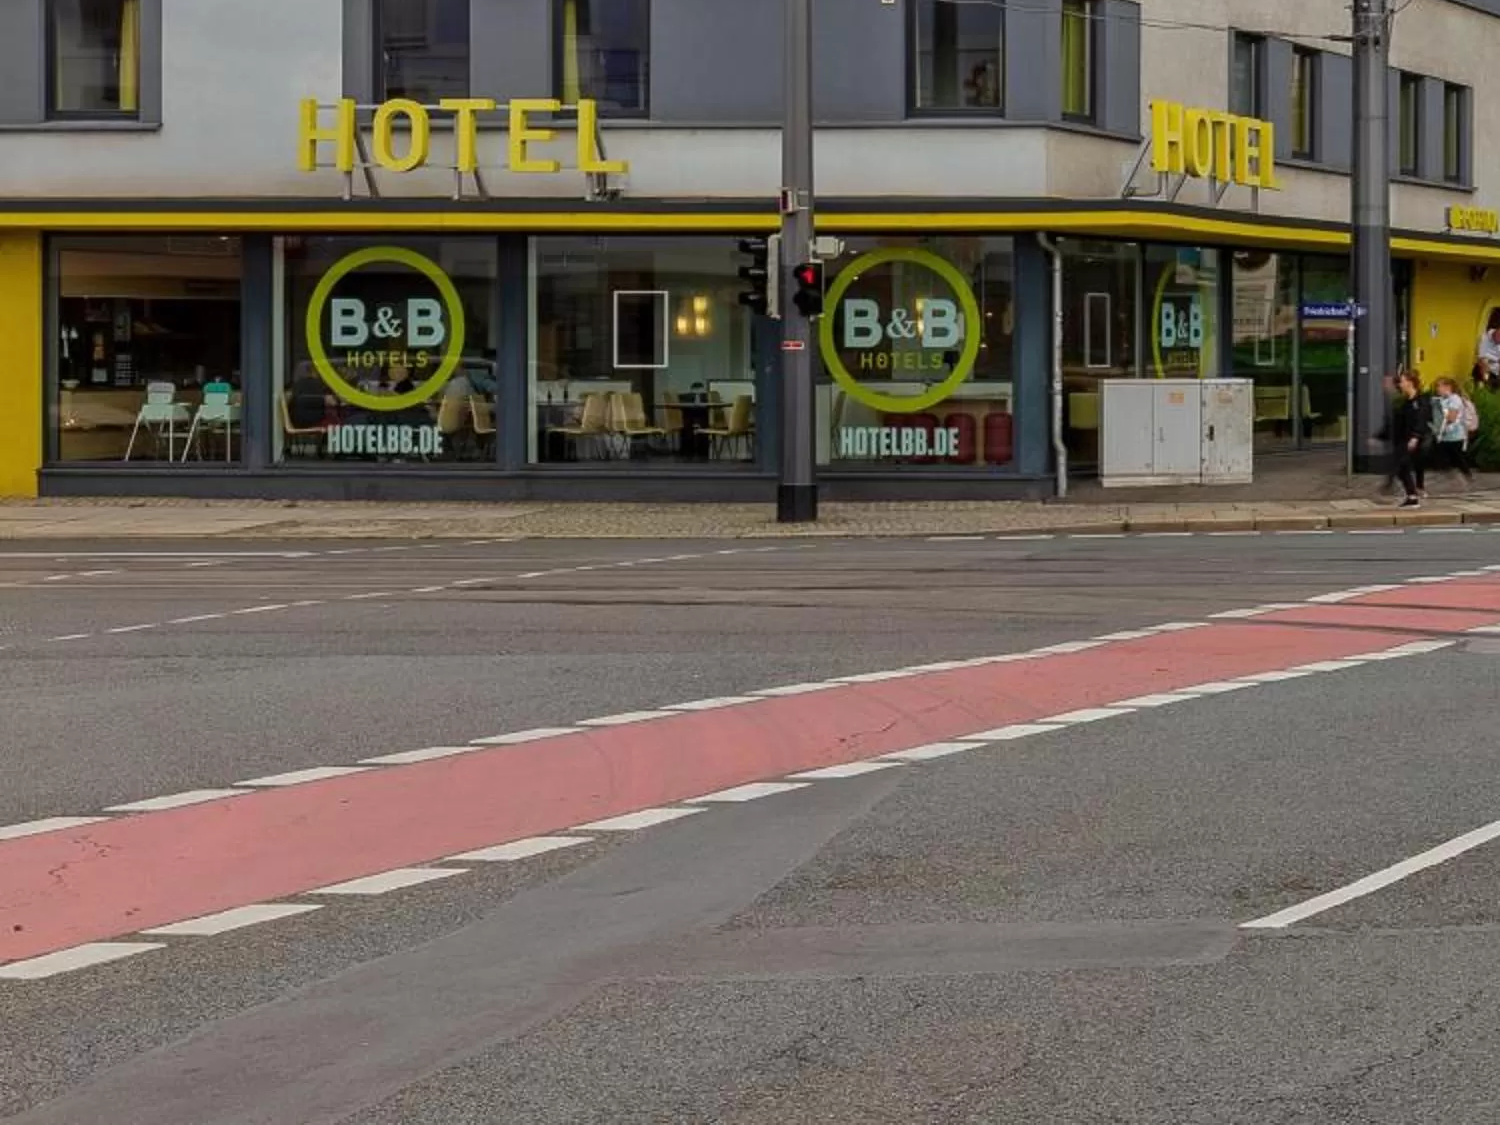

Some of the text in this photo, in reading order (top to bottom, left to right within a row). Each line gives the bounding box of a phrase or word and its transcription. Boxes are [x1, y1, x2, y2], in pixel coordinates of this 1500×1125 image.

[299, 98, 629, 173] HOTEL
[1151, 99, 1281, 191] HOTEL
[330, 297, 446, 347] B&B
[843, 298, 958, 348] B&B
[1161, 302, 1203, 348] B&B
[346, 350, 429, 368] HOTELS
[860, 351, 944, 370] HOTELS
[326, 424, 443, 454] HOTELBB.DE
[840, 427, 959, 456] HOTELBB.DE
